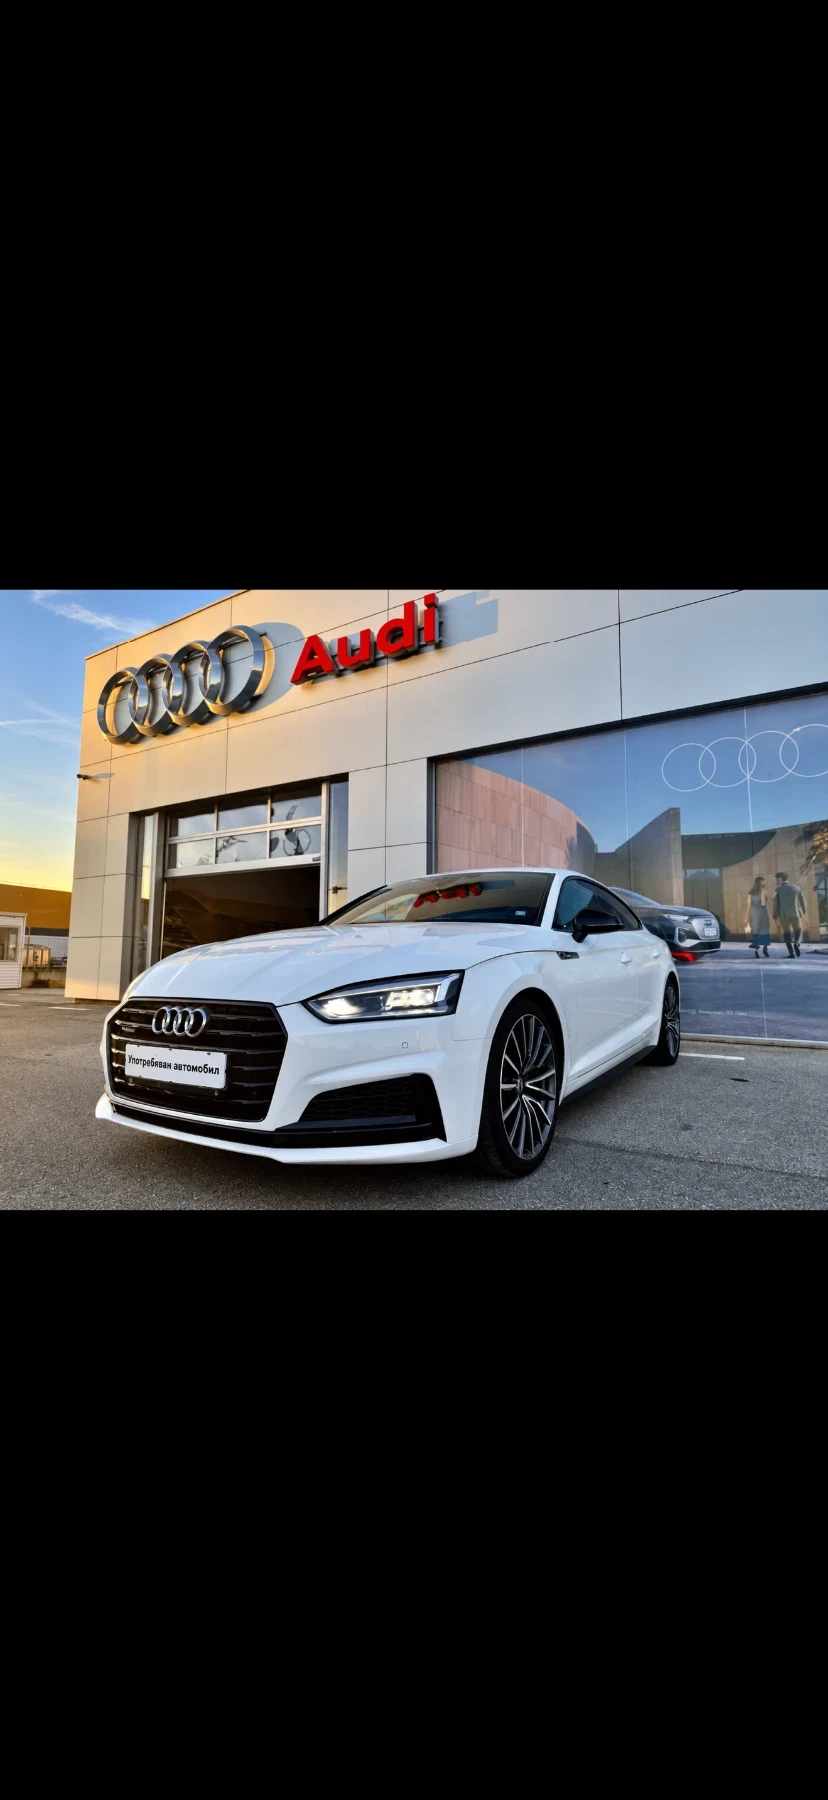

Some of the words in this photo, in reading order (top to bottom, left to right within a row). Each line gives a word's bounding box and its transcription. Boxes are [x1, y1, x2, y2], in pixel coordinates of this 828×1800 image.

[291, 593, 438, 684] Audi
[128, 1055, 172, 1070] Употребяван
[173, 1063, 220, 1075] автомобил
